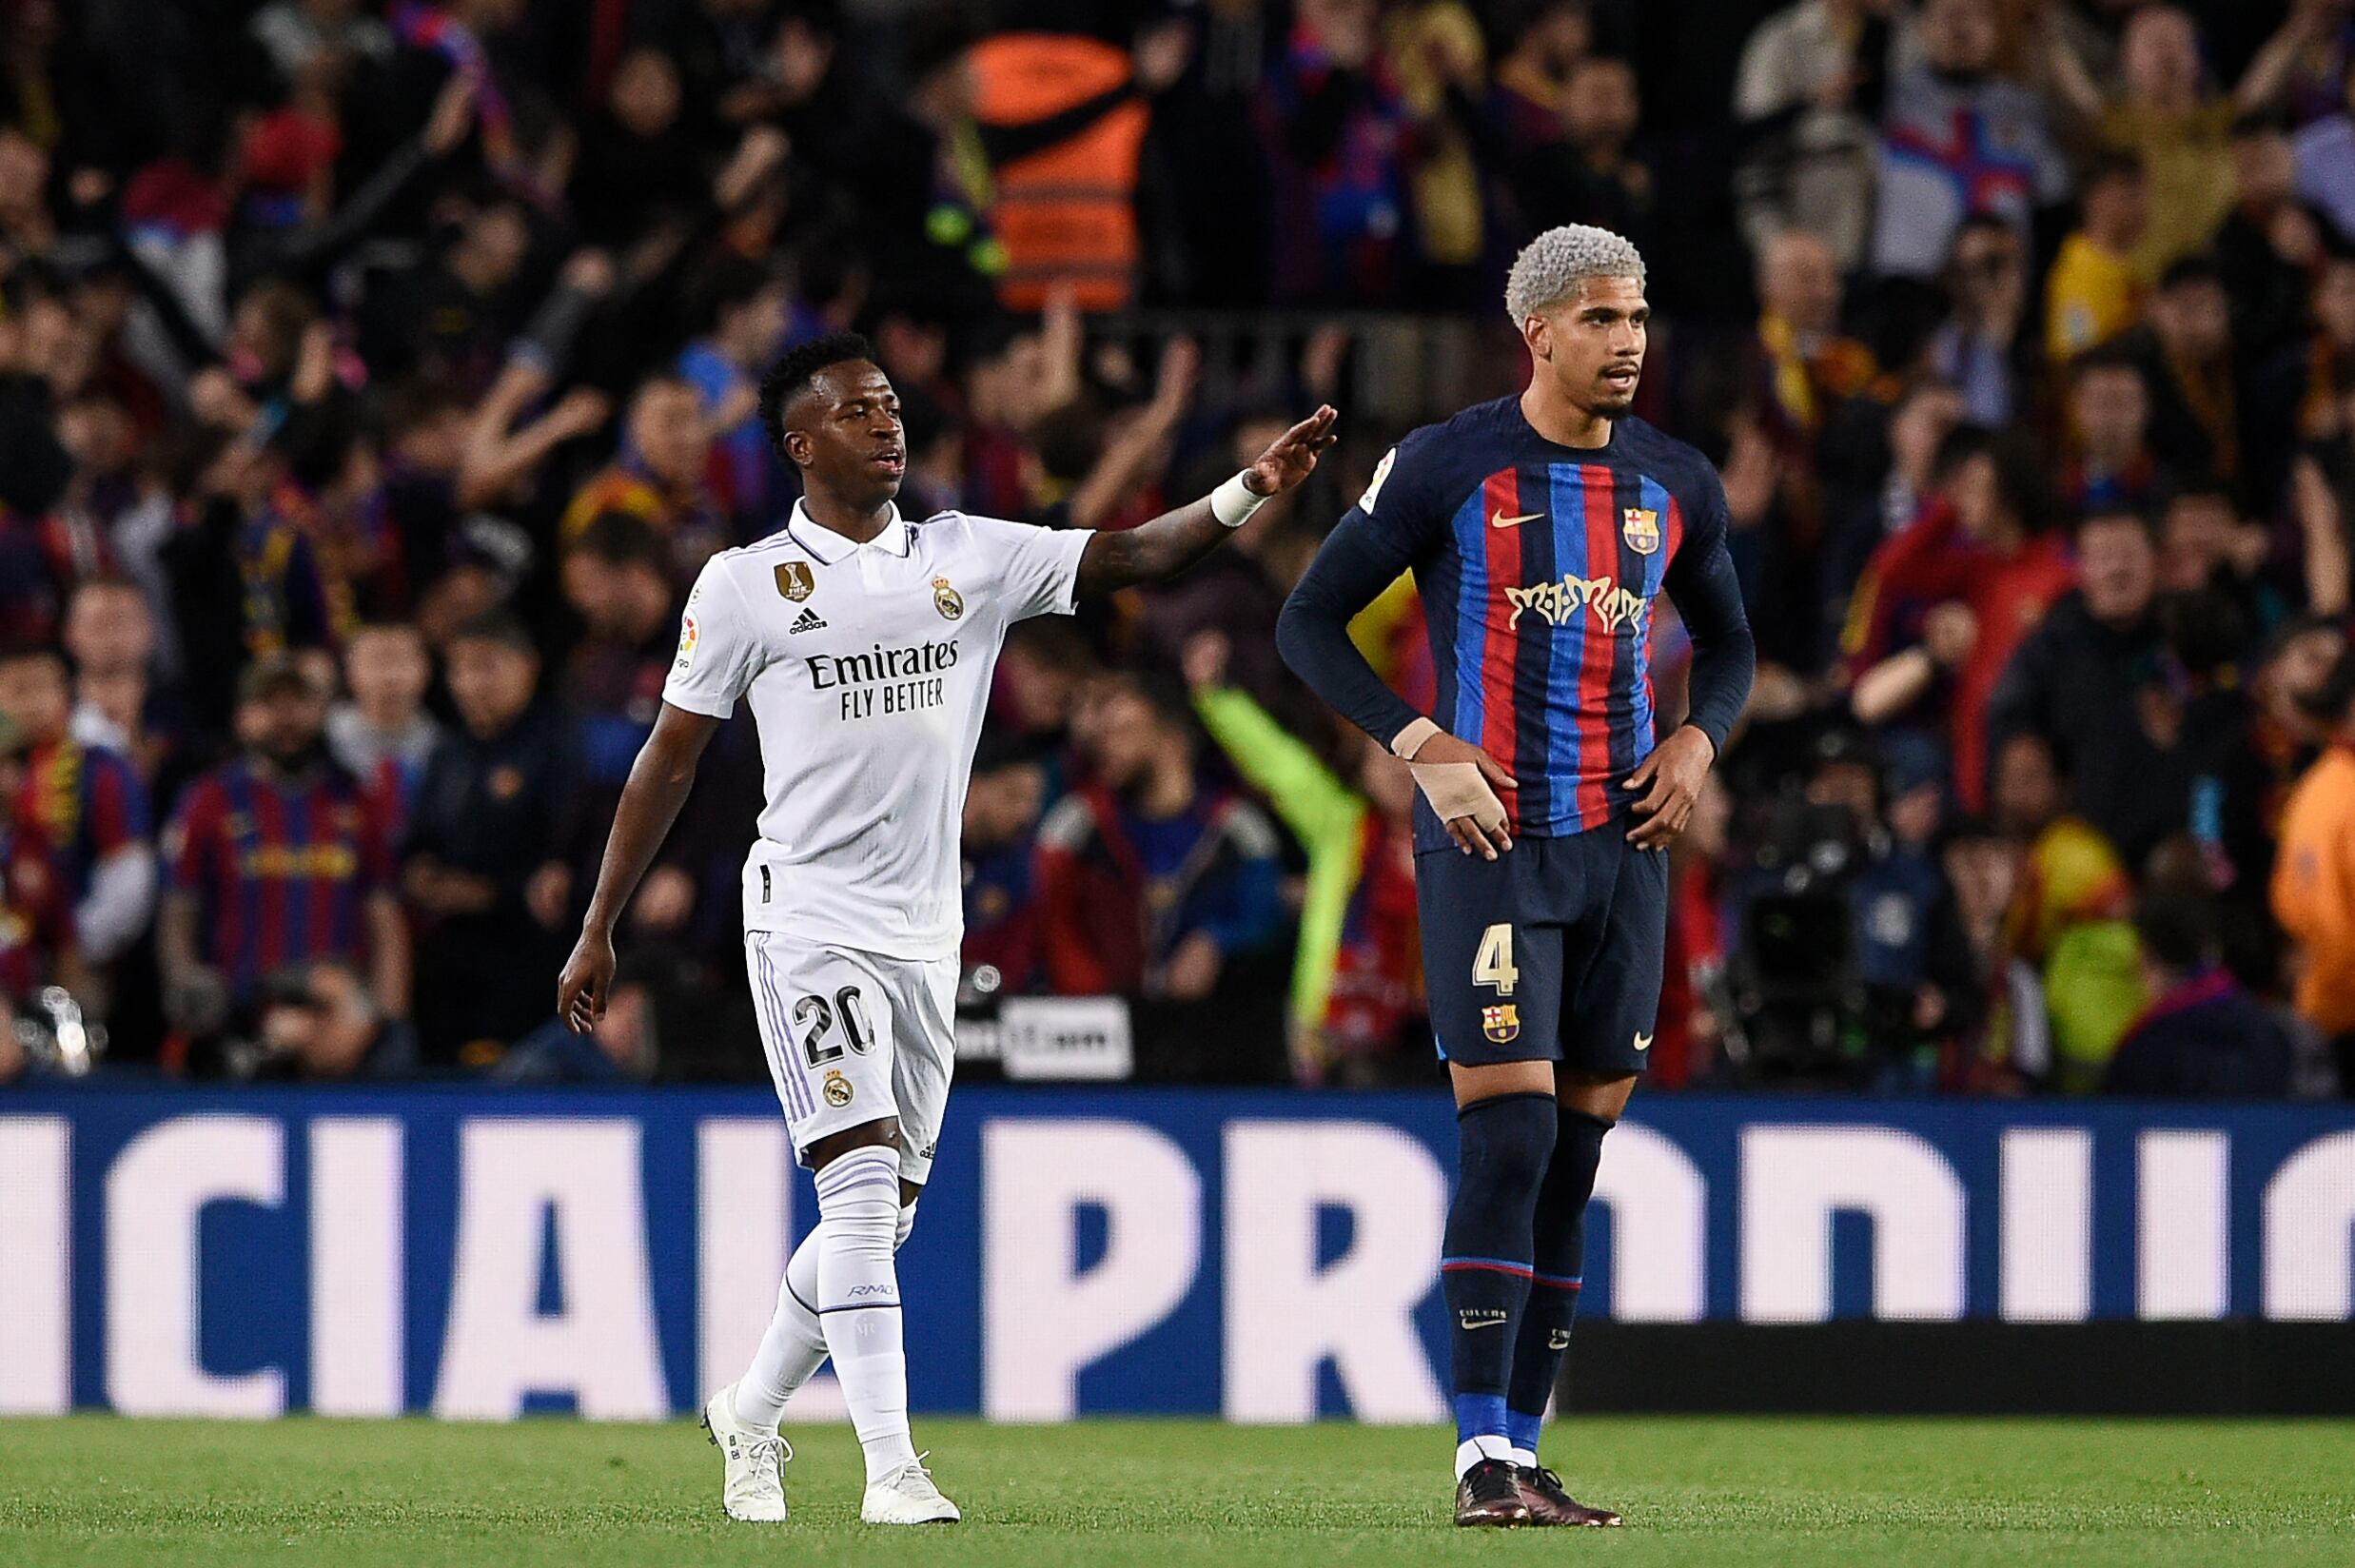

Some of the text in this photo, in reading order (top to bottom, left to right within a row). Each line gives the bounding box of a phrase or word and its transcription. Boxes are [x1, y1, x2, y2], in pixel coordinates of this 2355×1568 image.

[789, 619, 828, 636] adidas
[804, 639, 959, 690] Emirates
[841, 677, 944, 721] FLY BETTER
[1472, 922, 1520, 996] 4
[792, 985, 876, 1070] 20
[980, 1116, 2355, 1422] PRDU
